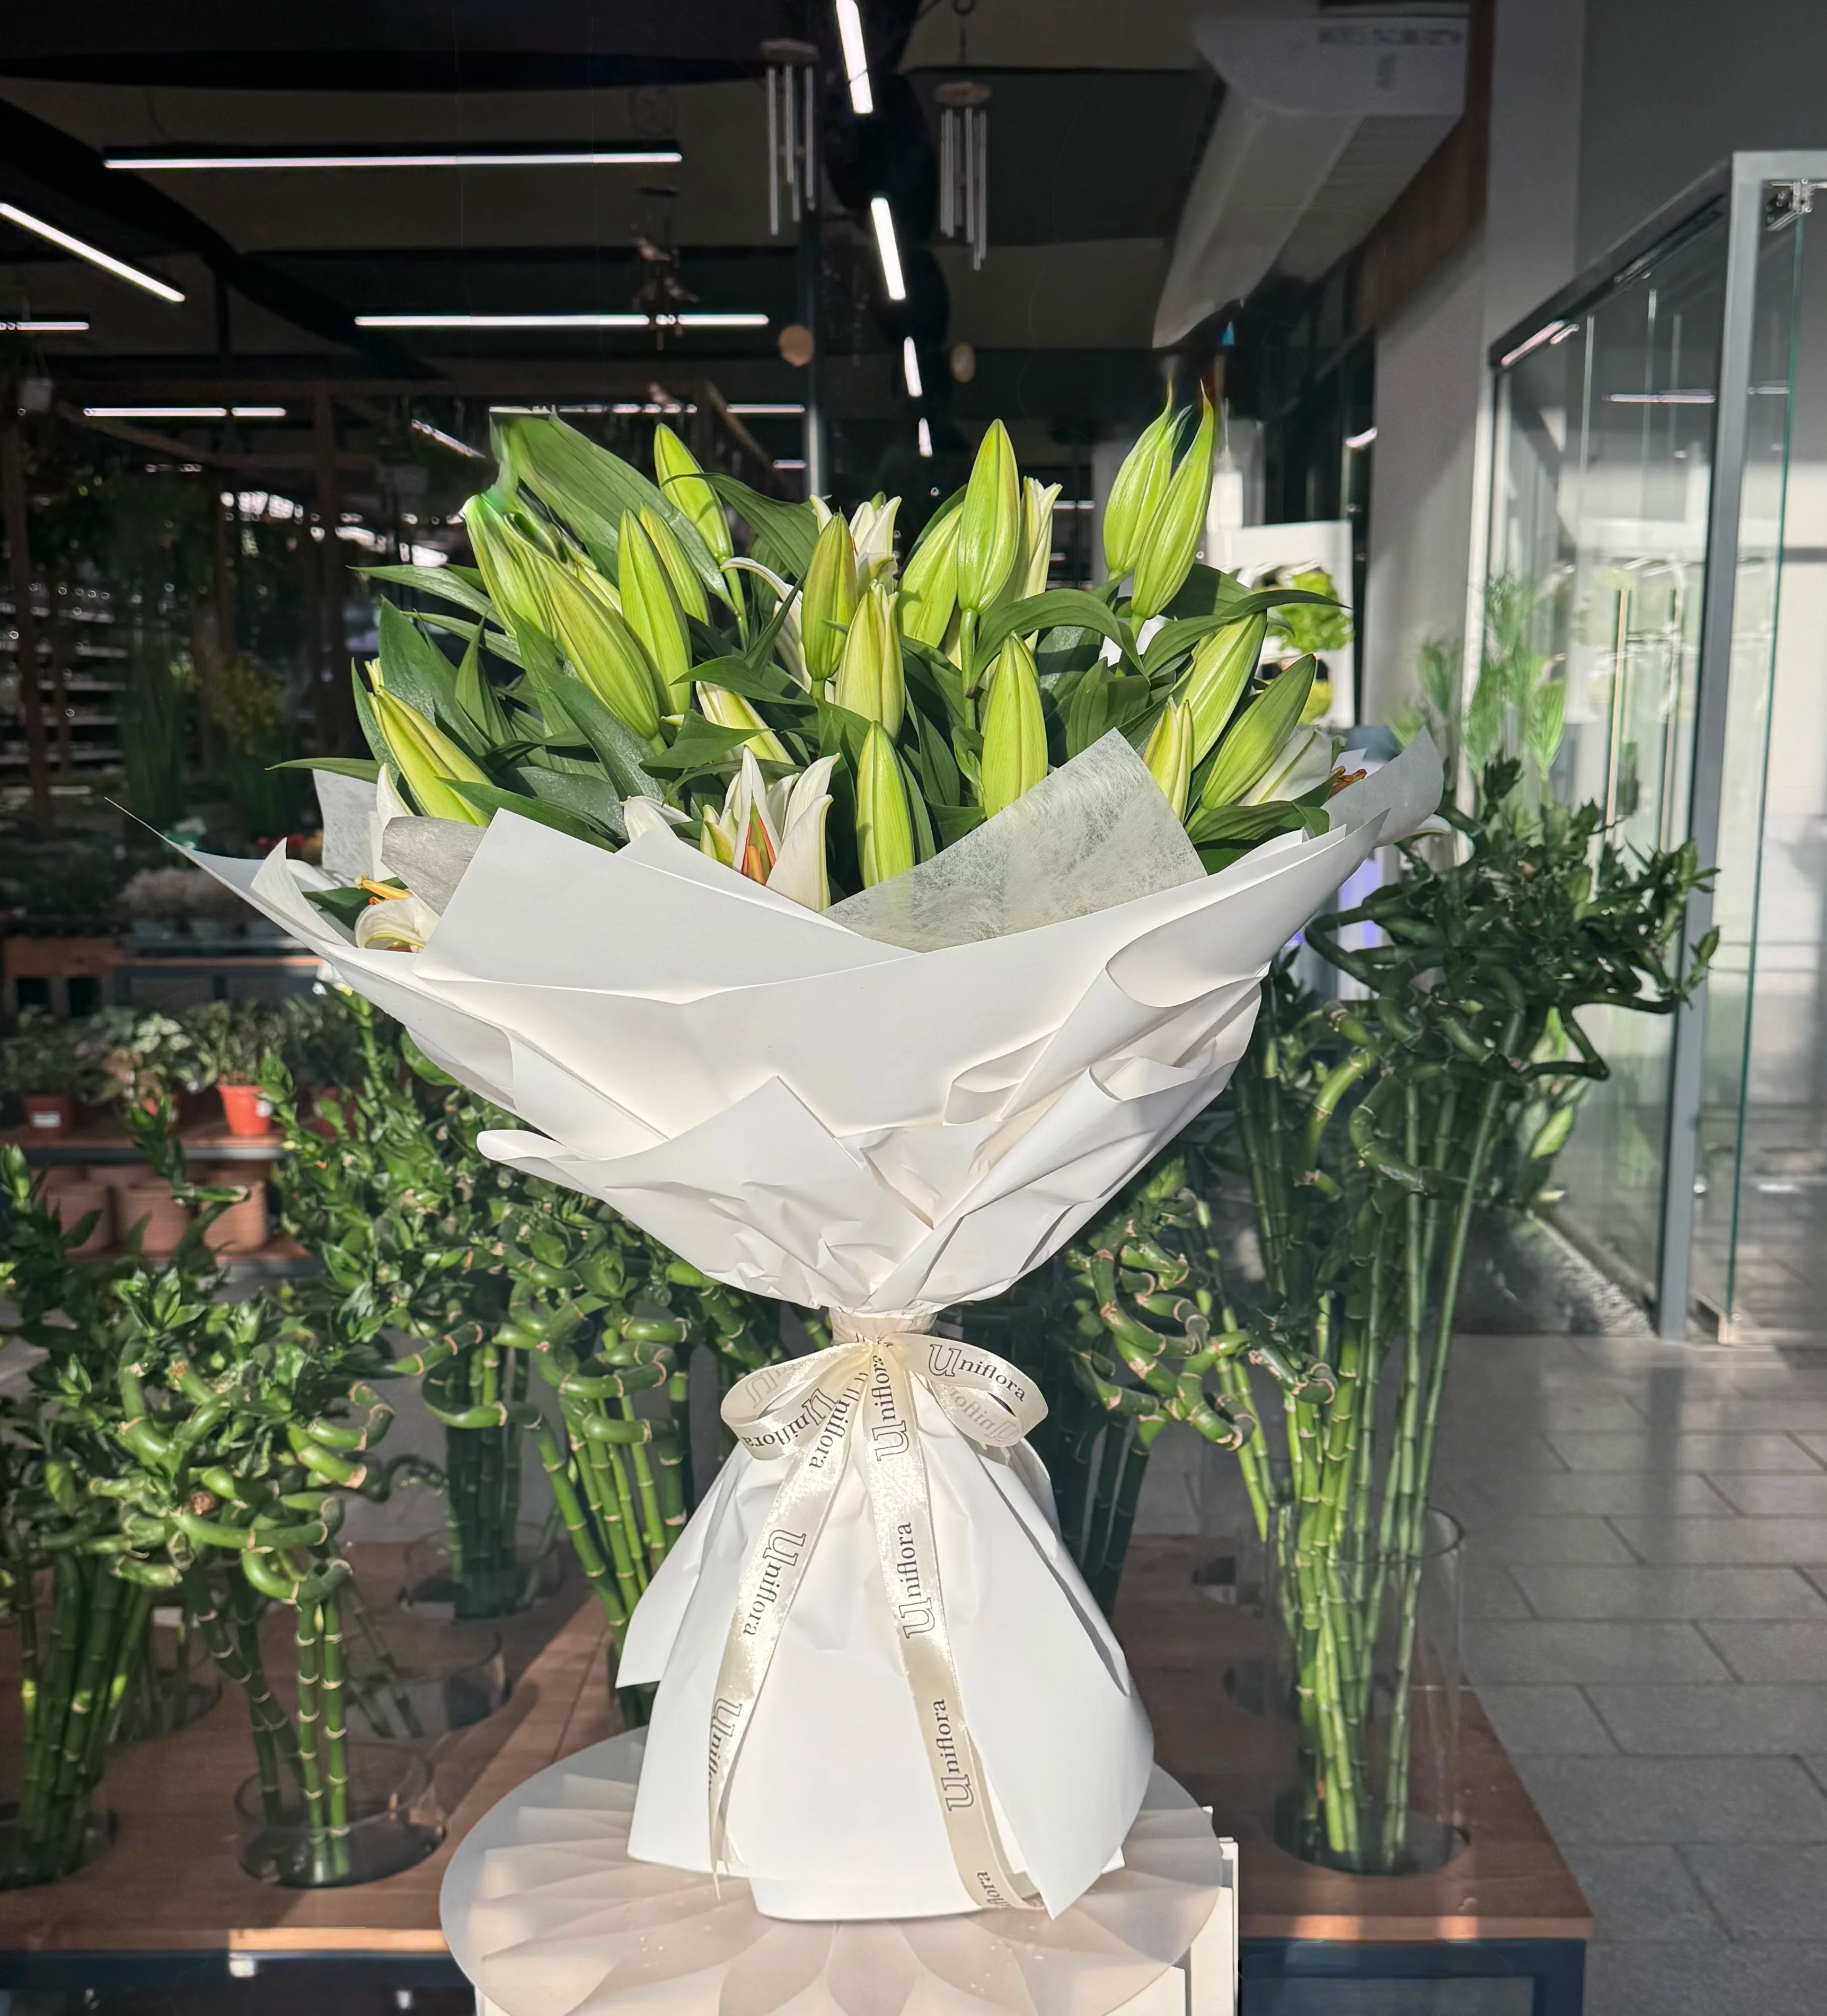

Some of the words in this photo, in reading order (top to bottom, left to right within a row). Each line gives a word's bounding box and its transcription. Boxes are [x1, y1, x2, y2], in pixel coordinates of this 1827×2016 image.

[742, 1388, 838, 1446] Uniflora
[872, 1355, 910, 1461] Uniflora
[929, 1344, 1025, 1402] Uniflora
[744, 1529, 806, 1635] Uniflora
[897, 1522, 935, 1638] Uniflora
[933, 1699, 974, 1811] Uniflora
